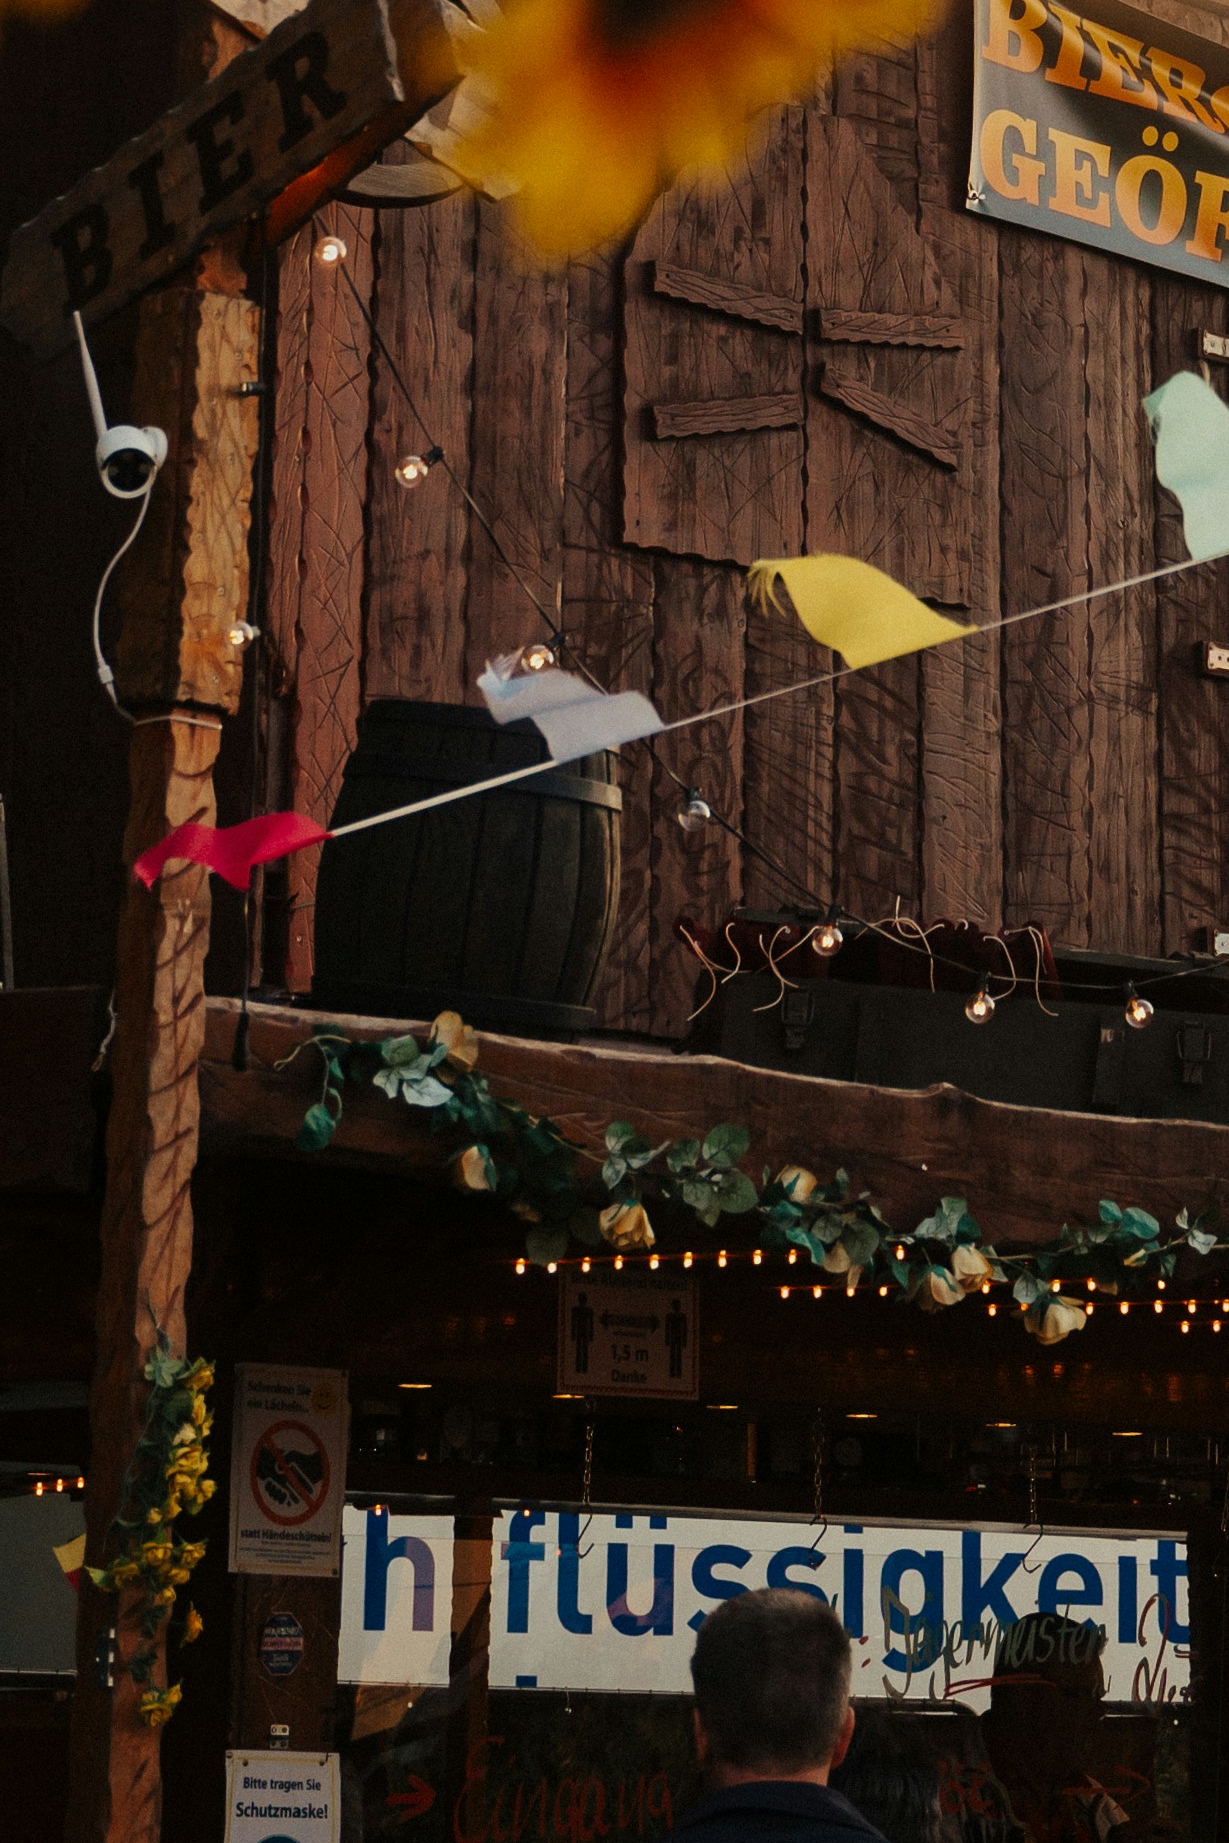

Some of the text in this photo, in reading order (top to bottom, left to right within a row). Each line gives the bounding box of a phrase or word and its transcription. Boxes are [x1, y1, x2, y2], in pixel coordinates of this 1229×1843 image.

[51, 30, 348, 307] BIER
[611, 1344, 649, 1363] 1,5 m
[611, 1369, 647, 1384] Danke
[240, 1528, 261, 1540] statt
[500, 1506, 1190, 1673] flüssigkeit
[242, 1776, 322, 1793] Bitte tragen Sie
[235, 1801, 328, 1819] Schutzmaske!
